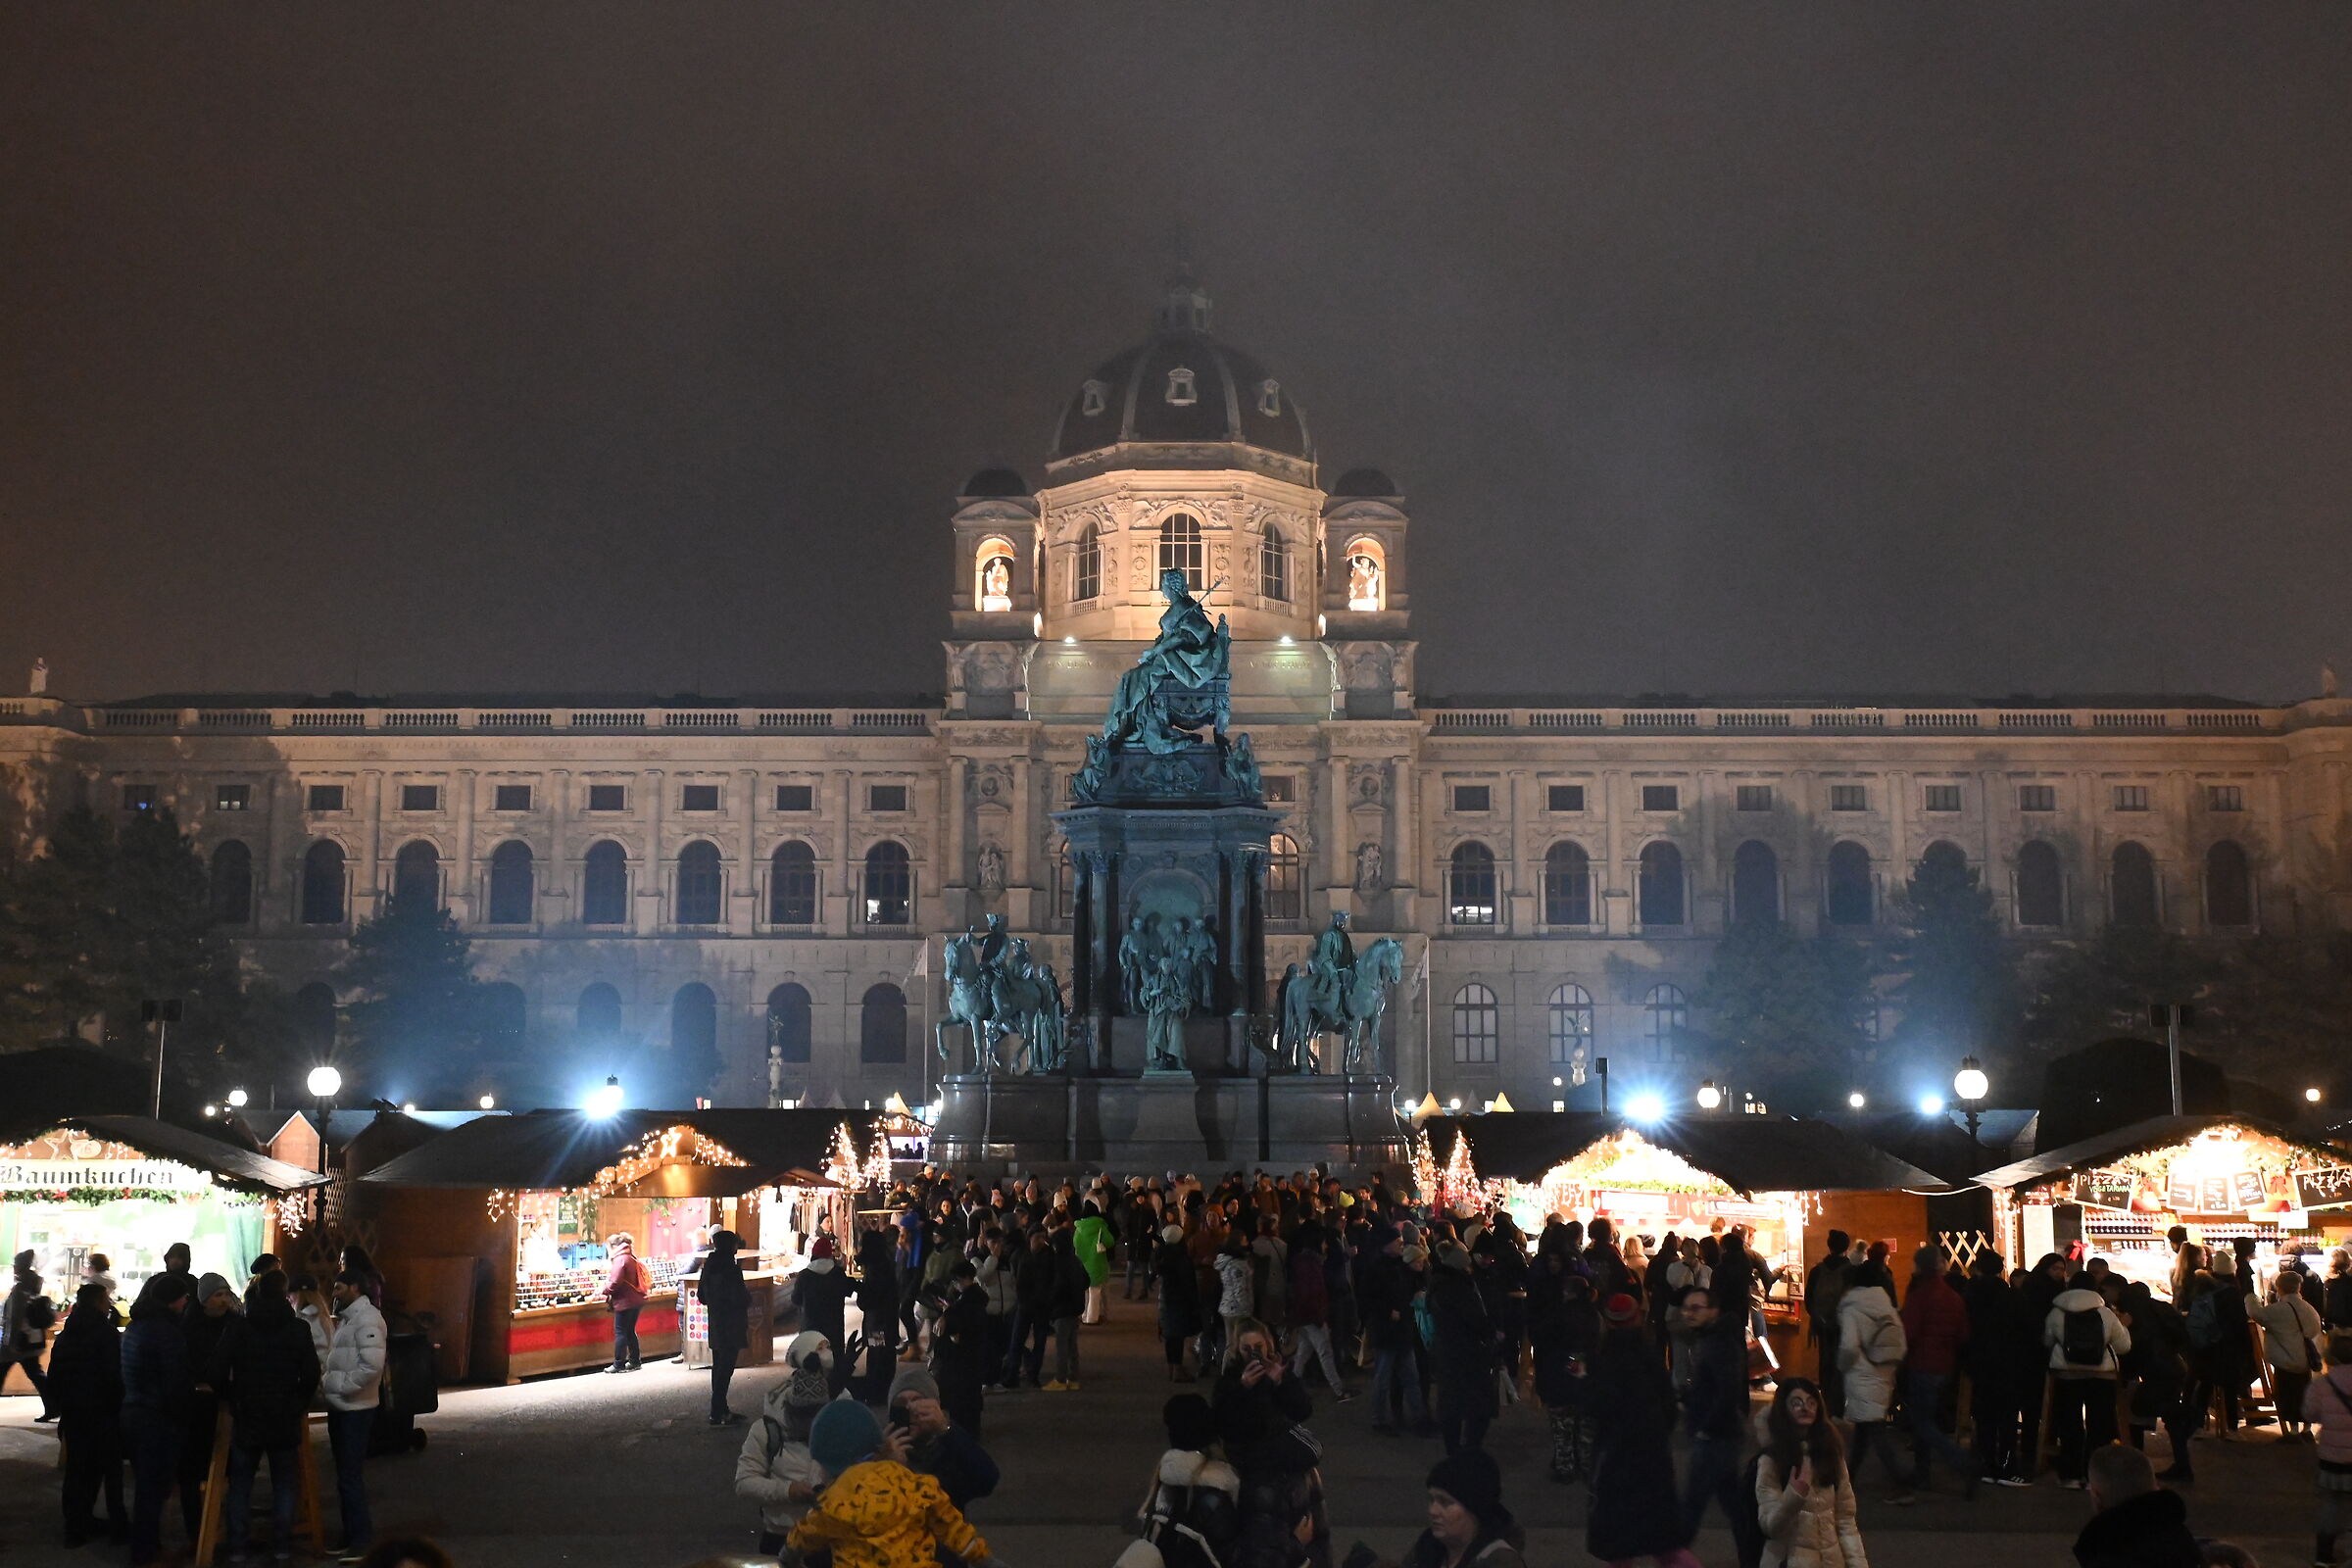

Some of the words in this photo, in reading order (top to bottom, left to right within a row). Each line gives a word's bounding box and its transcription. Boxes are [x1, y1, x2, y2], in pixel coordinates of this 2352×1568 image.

[1, 1166, 172, 1185] Baumkuchen
[2080, 1175, 2122, 1186] PIZZA
[2304, 1168, 2351, 1191] PIZZA
